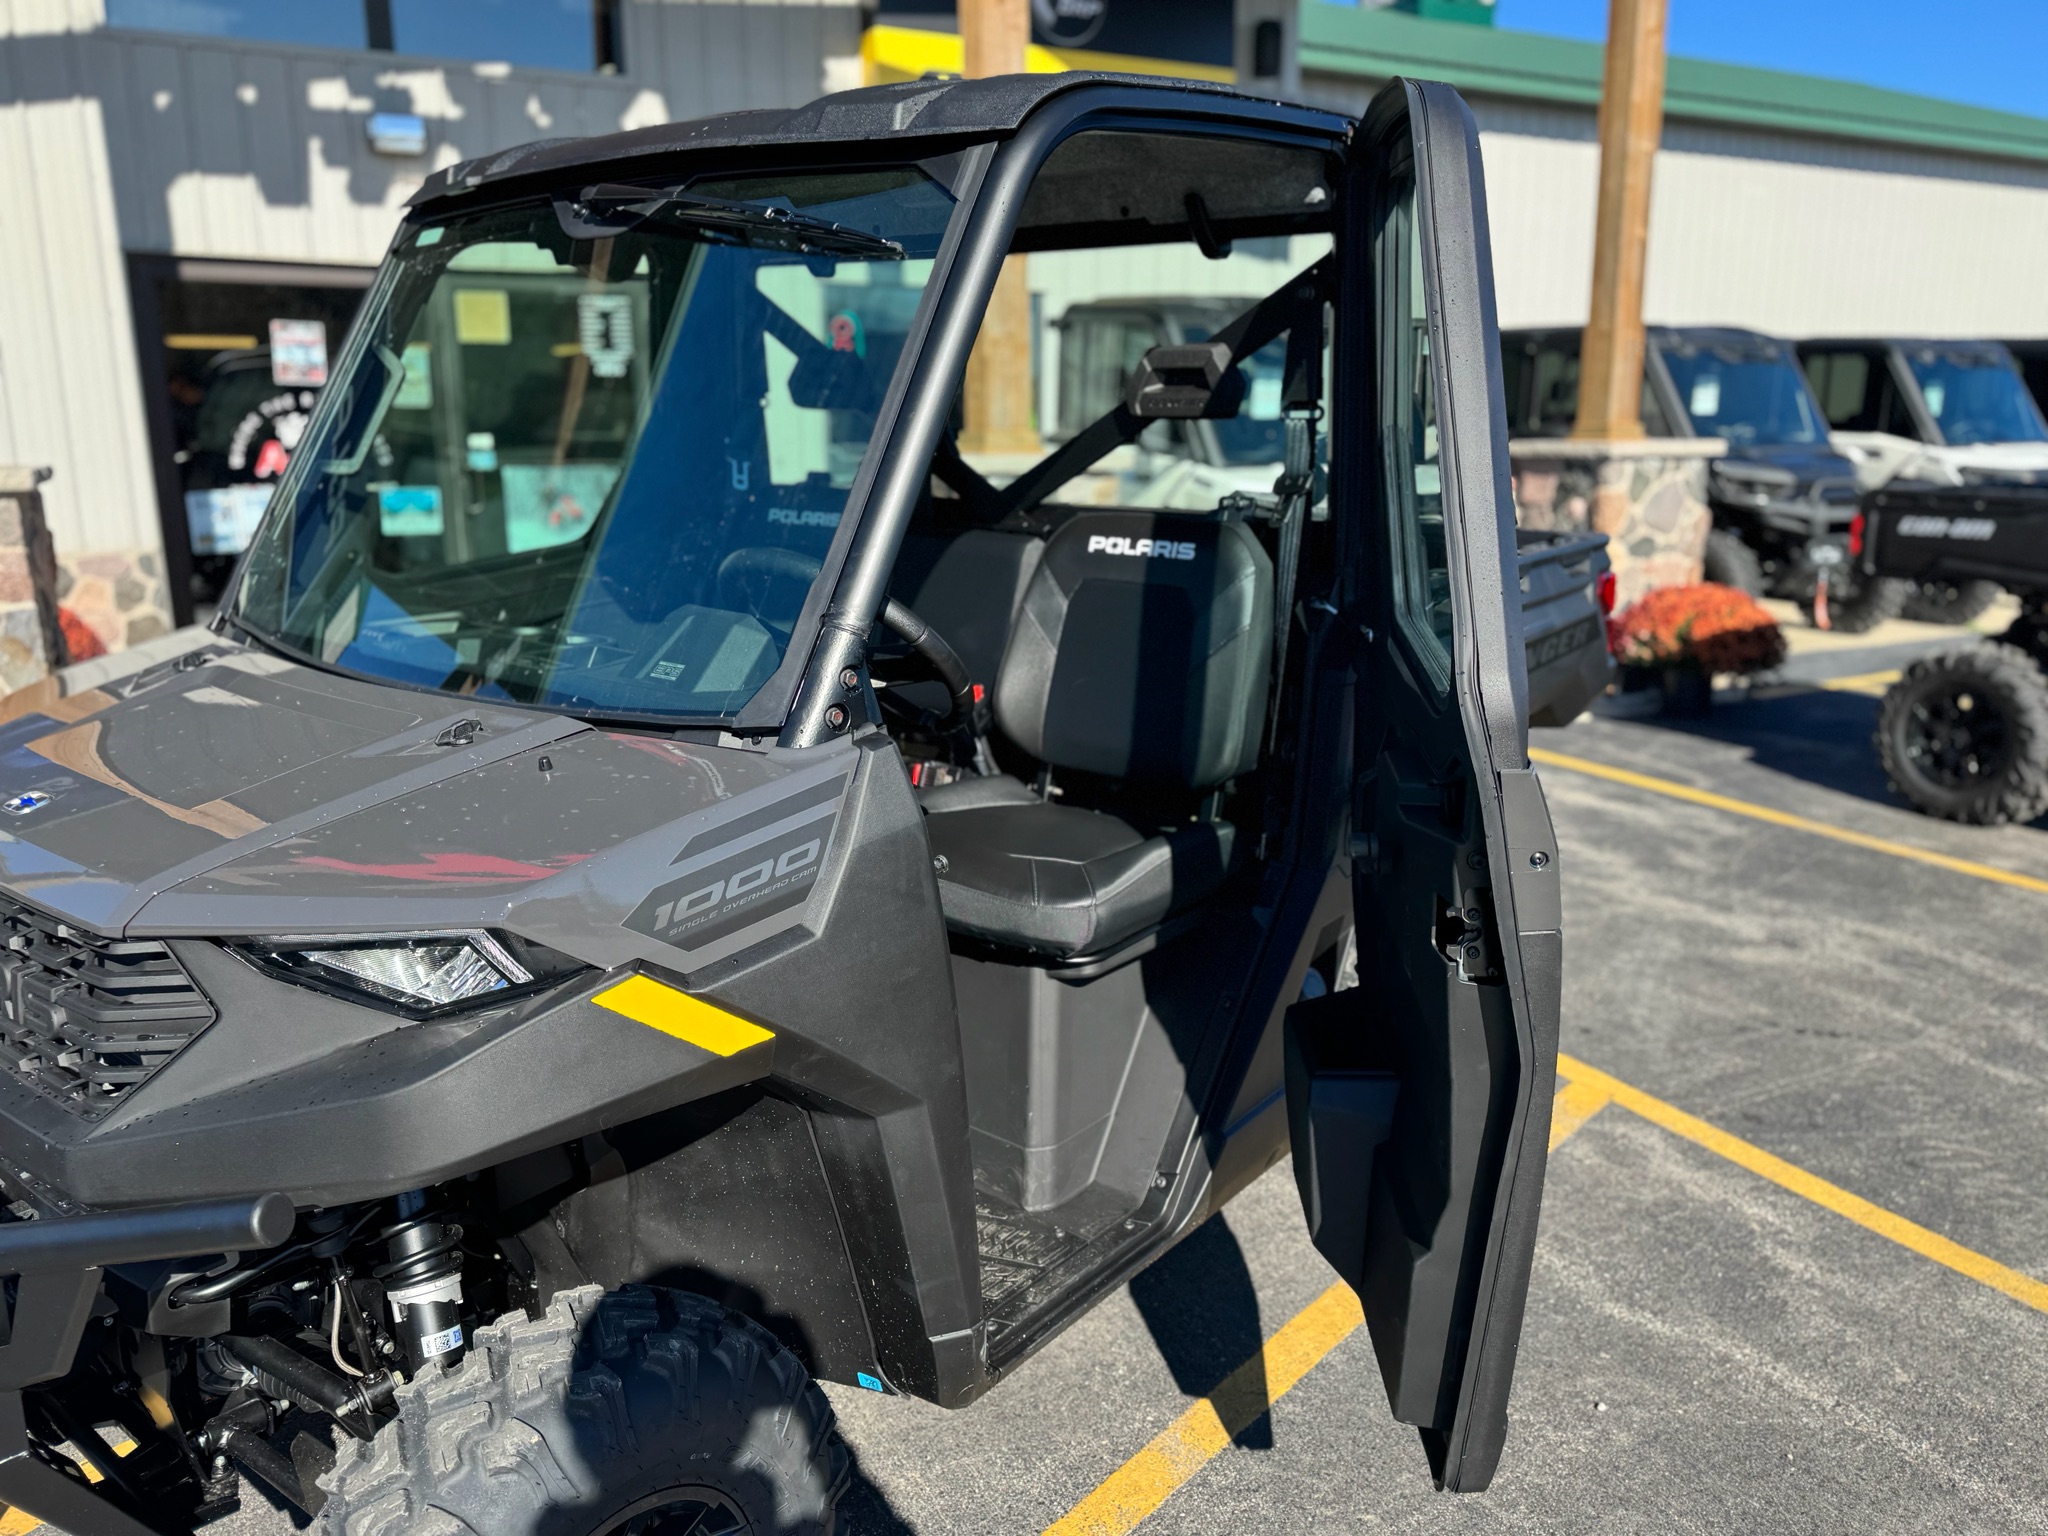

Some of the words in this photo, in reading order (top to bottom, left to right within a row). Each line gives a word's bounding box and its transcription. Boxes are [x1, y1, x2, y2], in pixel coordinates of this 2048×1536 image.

[1087, 535, 1196, 560] POLARIS
[653, 838, 821, 931] 1000
[668, 909, 718, 937] SINGLE
[722, 878, 789, 913] OVERHEAD
[791, 865, 817, 882] CAM
